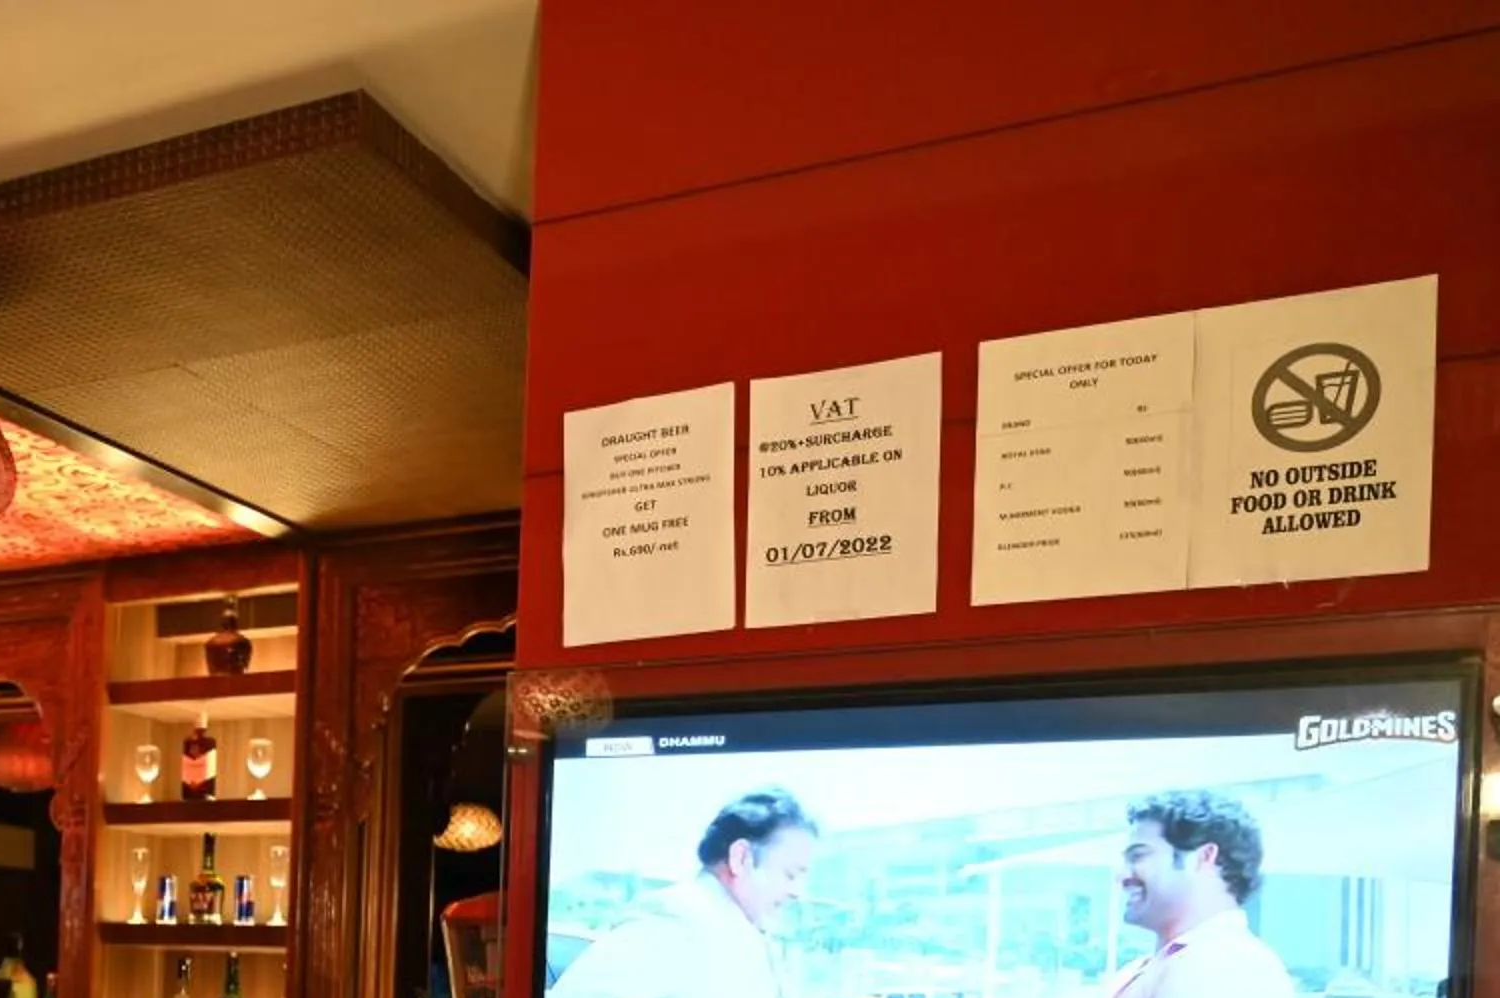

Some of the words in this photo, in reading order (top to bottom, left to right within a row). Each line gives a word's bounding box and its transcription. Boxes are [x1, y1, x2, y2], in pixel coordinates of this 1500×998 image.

[1014, 368, 1054, 381] SPECIAL
[1057, 362, 1091, 375] OFFER
[1094, 358, 1117, 370] FOR
[1120, 353, 1157, 367] TODAY
[1069, 377, 1098, 389] ONLY
[809, 397, 860, 421] VAT
[601, 428, 657, 447] DRAUGHT
[660, 424, 689, 438] BEER
[760, 464, 786, 478] 10%
[789, 450, 880, 475] APPLICABLE
[883, 448, 903, 462] ON
[1250, 469, 1280, 489] NO
[1285, 459, 1378, 485] OUTSIDE
[806, 480, 857, 497] LIQUOR
[1230, 492, 1287, 514] FOOD
[1293, 489, 1322, 508] OR
[1328, 481, 1397, 504] DRINK
[634, 500, 657, 512] GET
[808, 507, 856, 527] FROM
[602, 526, 626, 539] ONE
[629, 521, 659, 534] MUG
[661, 516, 689, 528] FREE
[1262, 509, 1361, 534] ALLOWED
[765, 534, 892, 564] 01/07/2022
[658, 735, 726, 748] DHAMMU
[1297, 710, 1456, 750] GOLDMINES
